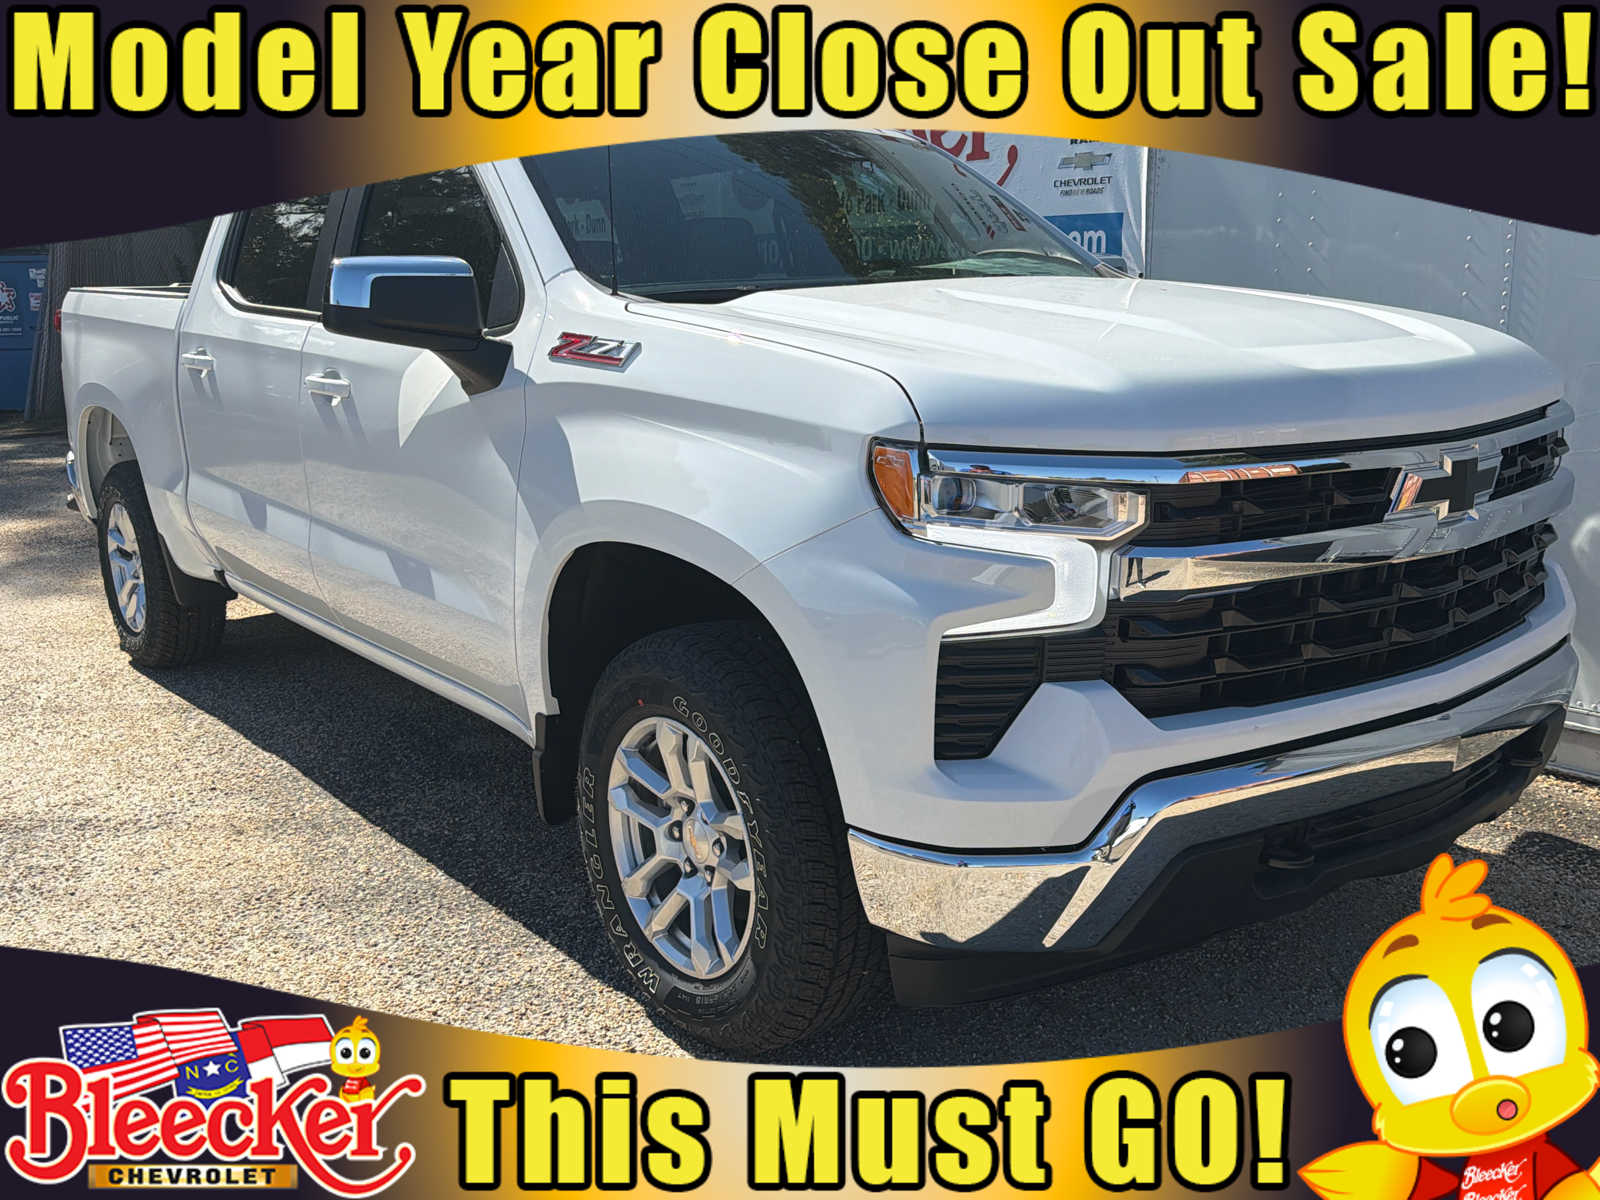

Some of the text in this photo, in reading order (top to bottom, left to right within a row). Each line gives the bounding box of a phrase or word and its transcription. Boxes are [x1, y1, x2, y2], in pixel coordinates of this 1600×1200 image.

[1053, 175, 1113, 189] CHEVROLET
[548, 331, 641, 370] Z71
[583, 767, 660, 993] WRANGLER
[673, 696, 769, 949] GOODYEAR
